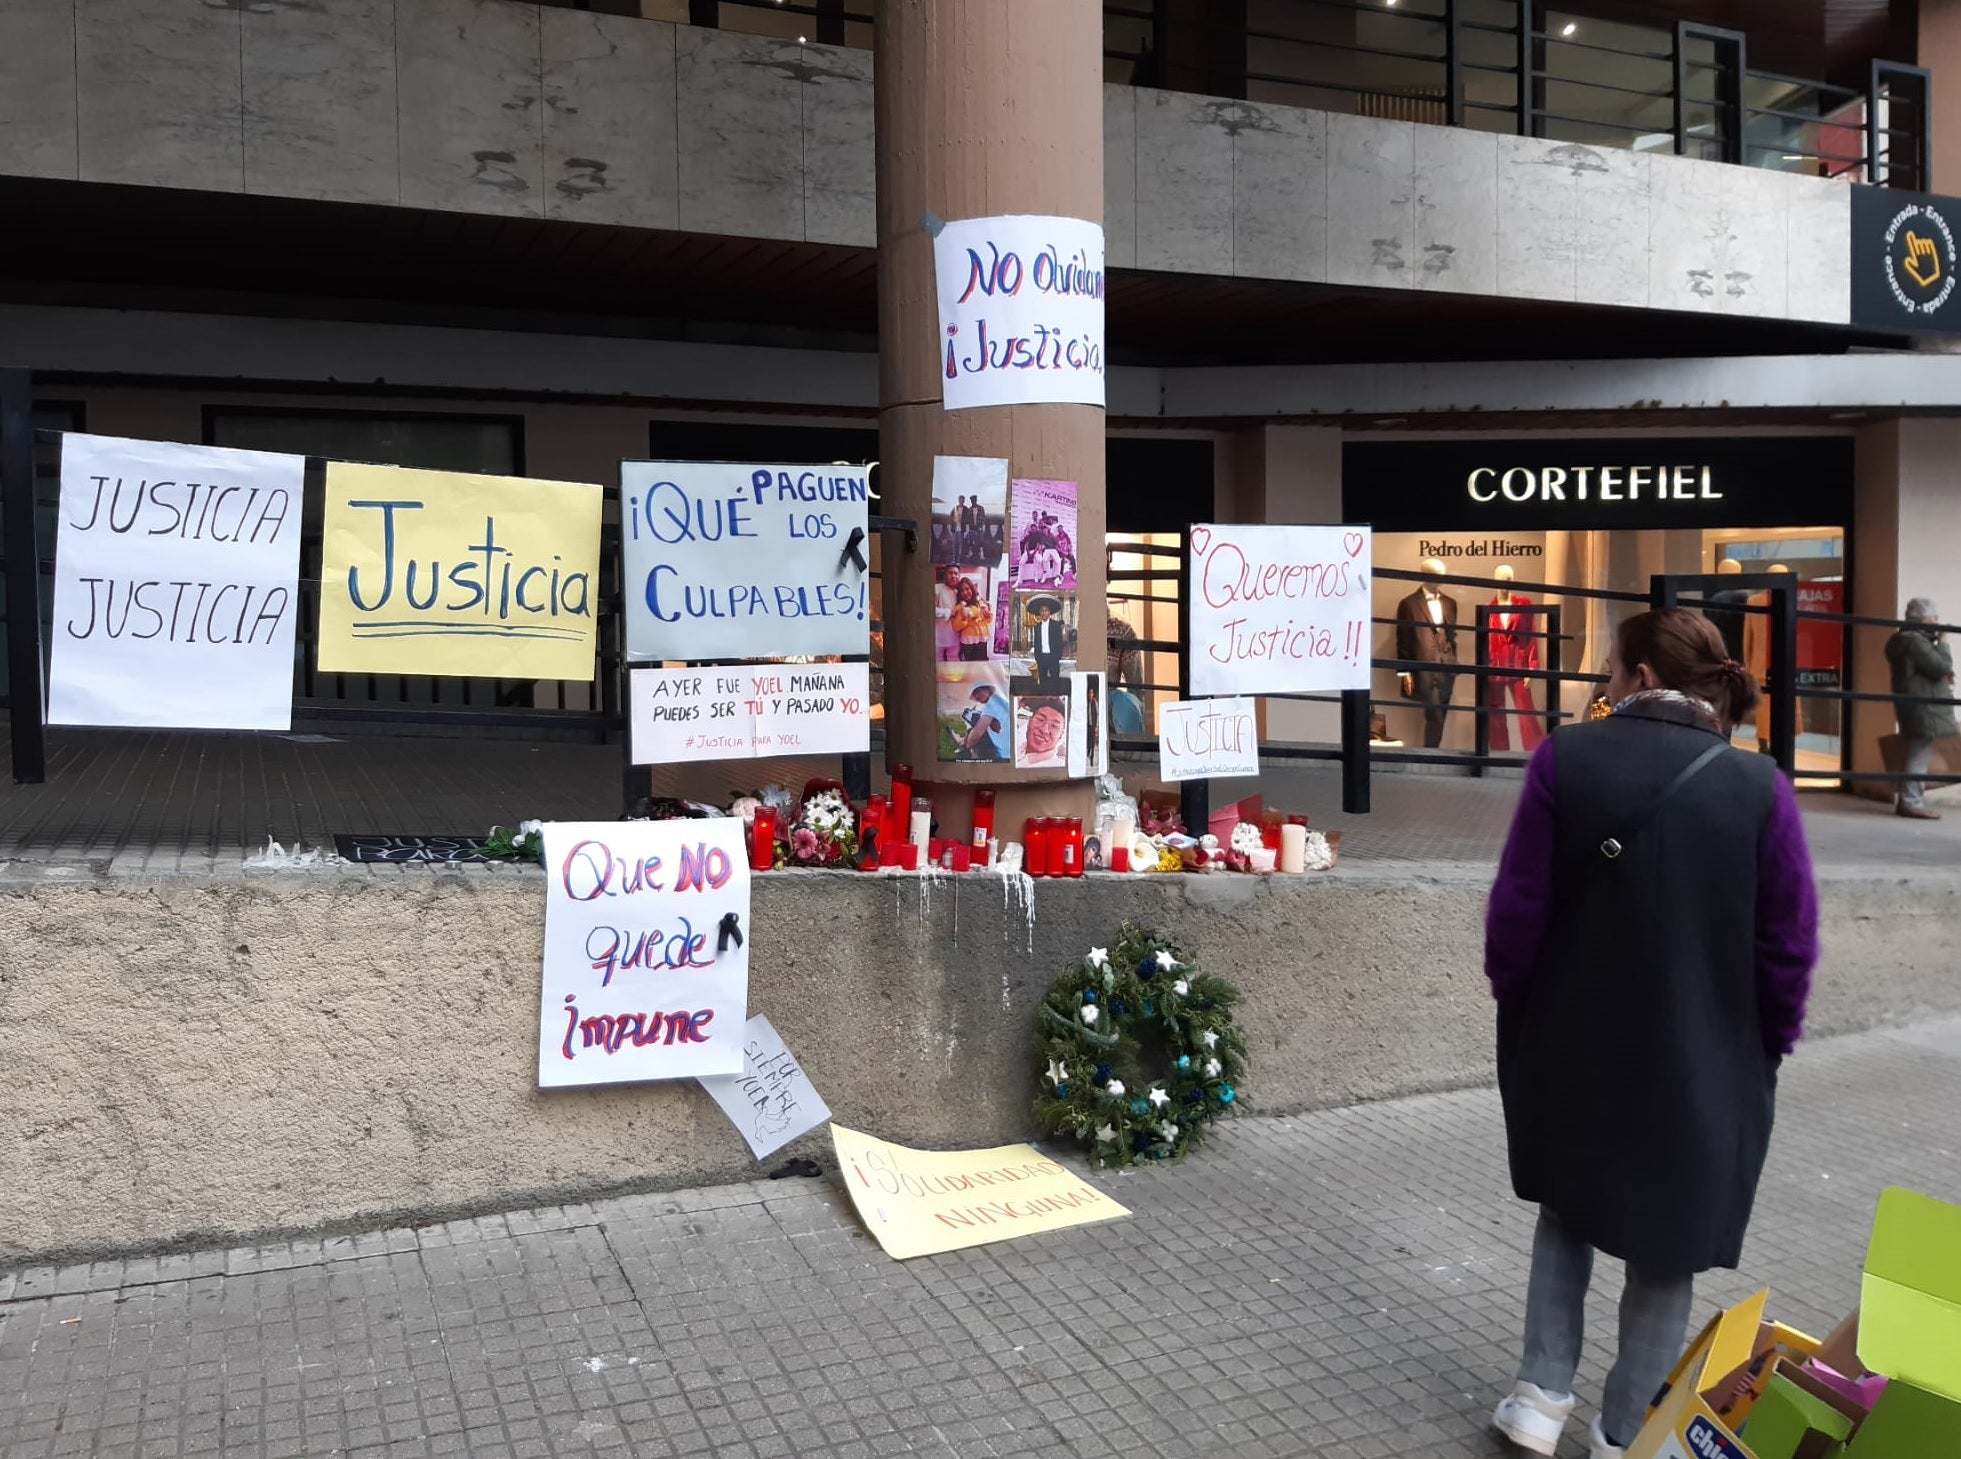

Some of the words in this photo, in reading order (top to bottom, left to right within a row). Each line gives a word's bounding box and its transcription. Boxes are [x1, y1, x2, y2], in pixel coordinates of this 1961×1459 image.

[1885, 204, 1918, 243] Entrada
[1926, 205, 1957, 262] Entrance
[957, 241, 1024, 304] NO
[1885, 255, 1916, 313] Entrance
[1923, 275, 1956, 314] Entrada
[752, 469, 867, 505] PAGUEN
[1467, 465, 1723, 502] CORTEFIEL
[70, 476, 290, 544] JUSTICIA
[788, 513, 837, 539] LOS
[348, 500, 592, 620] Justicia
[1419, 540, 1463, 557] Pedro
[1465, 540, 1488, 557] del
[1492, 540, 1543, 557] Hierro
[1203, 543, 1350, 609] Queremos
[1796, 589, 1833, 602] AJAS
[67, 578, 289, 644] JUSTICIA
[653, 677, 703, 698] AYER
[717, 678, 741, 696] FUE
[752, 676, 784, 697] YOEL
[790, 672, 845, 693] MAÑANA
[653, 704, 700, 722] PUEDES
[710, 702, 736, 719] SER
[744, 697, 764, 719] TÚ
[773, 699, 782, 715] Y
[786, 697, 835, 715] PASADO
[777, 733, 802, 746] YOEL
[562, 840, 664, 901] Que
[674, 842, 733, 893] NO
[1690, 1424, 1729, 1459] chi
